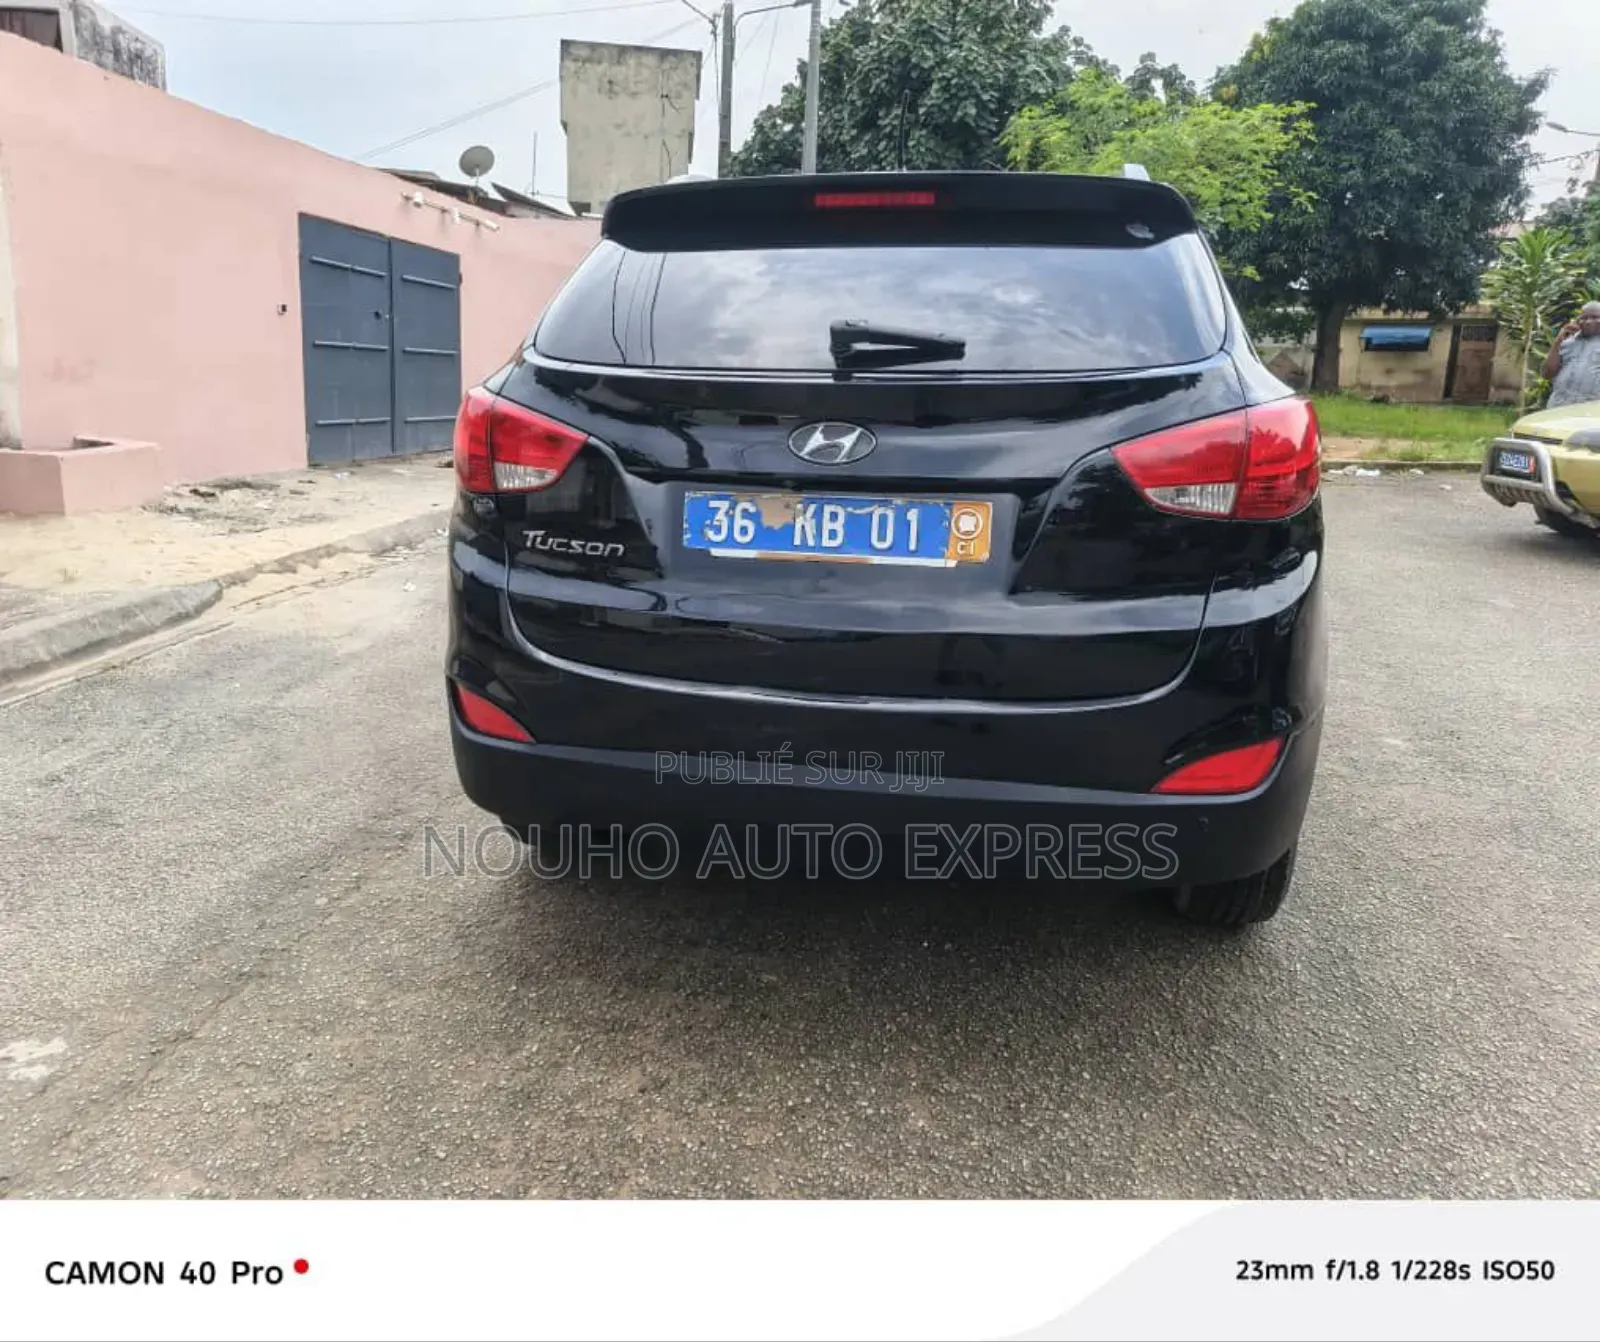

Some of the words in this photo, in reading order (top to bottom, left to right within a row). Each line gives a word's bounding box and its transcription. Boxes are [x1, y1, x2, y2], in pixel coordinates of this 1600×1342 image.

[521, 529, 625, 557] Tucson
[704, 499, 757, 543] 36
[793, 502, 845, 548] KB
[870, 505, 918, 551] 01
